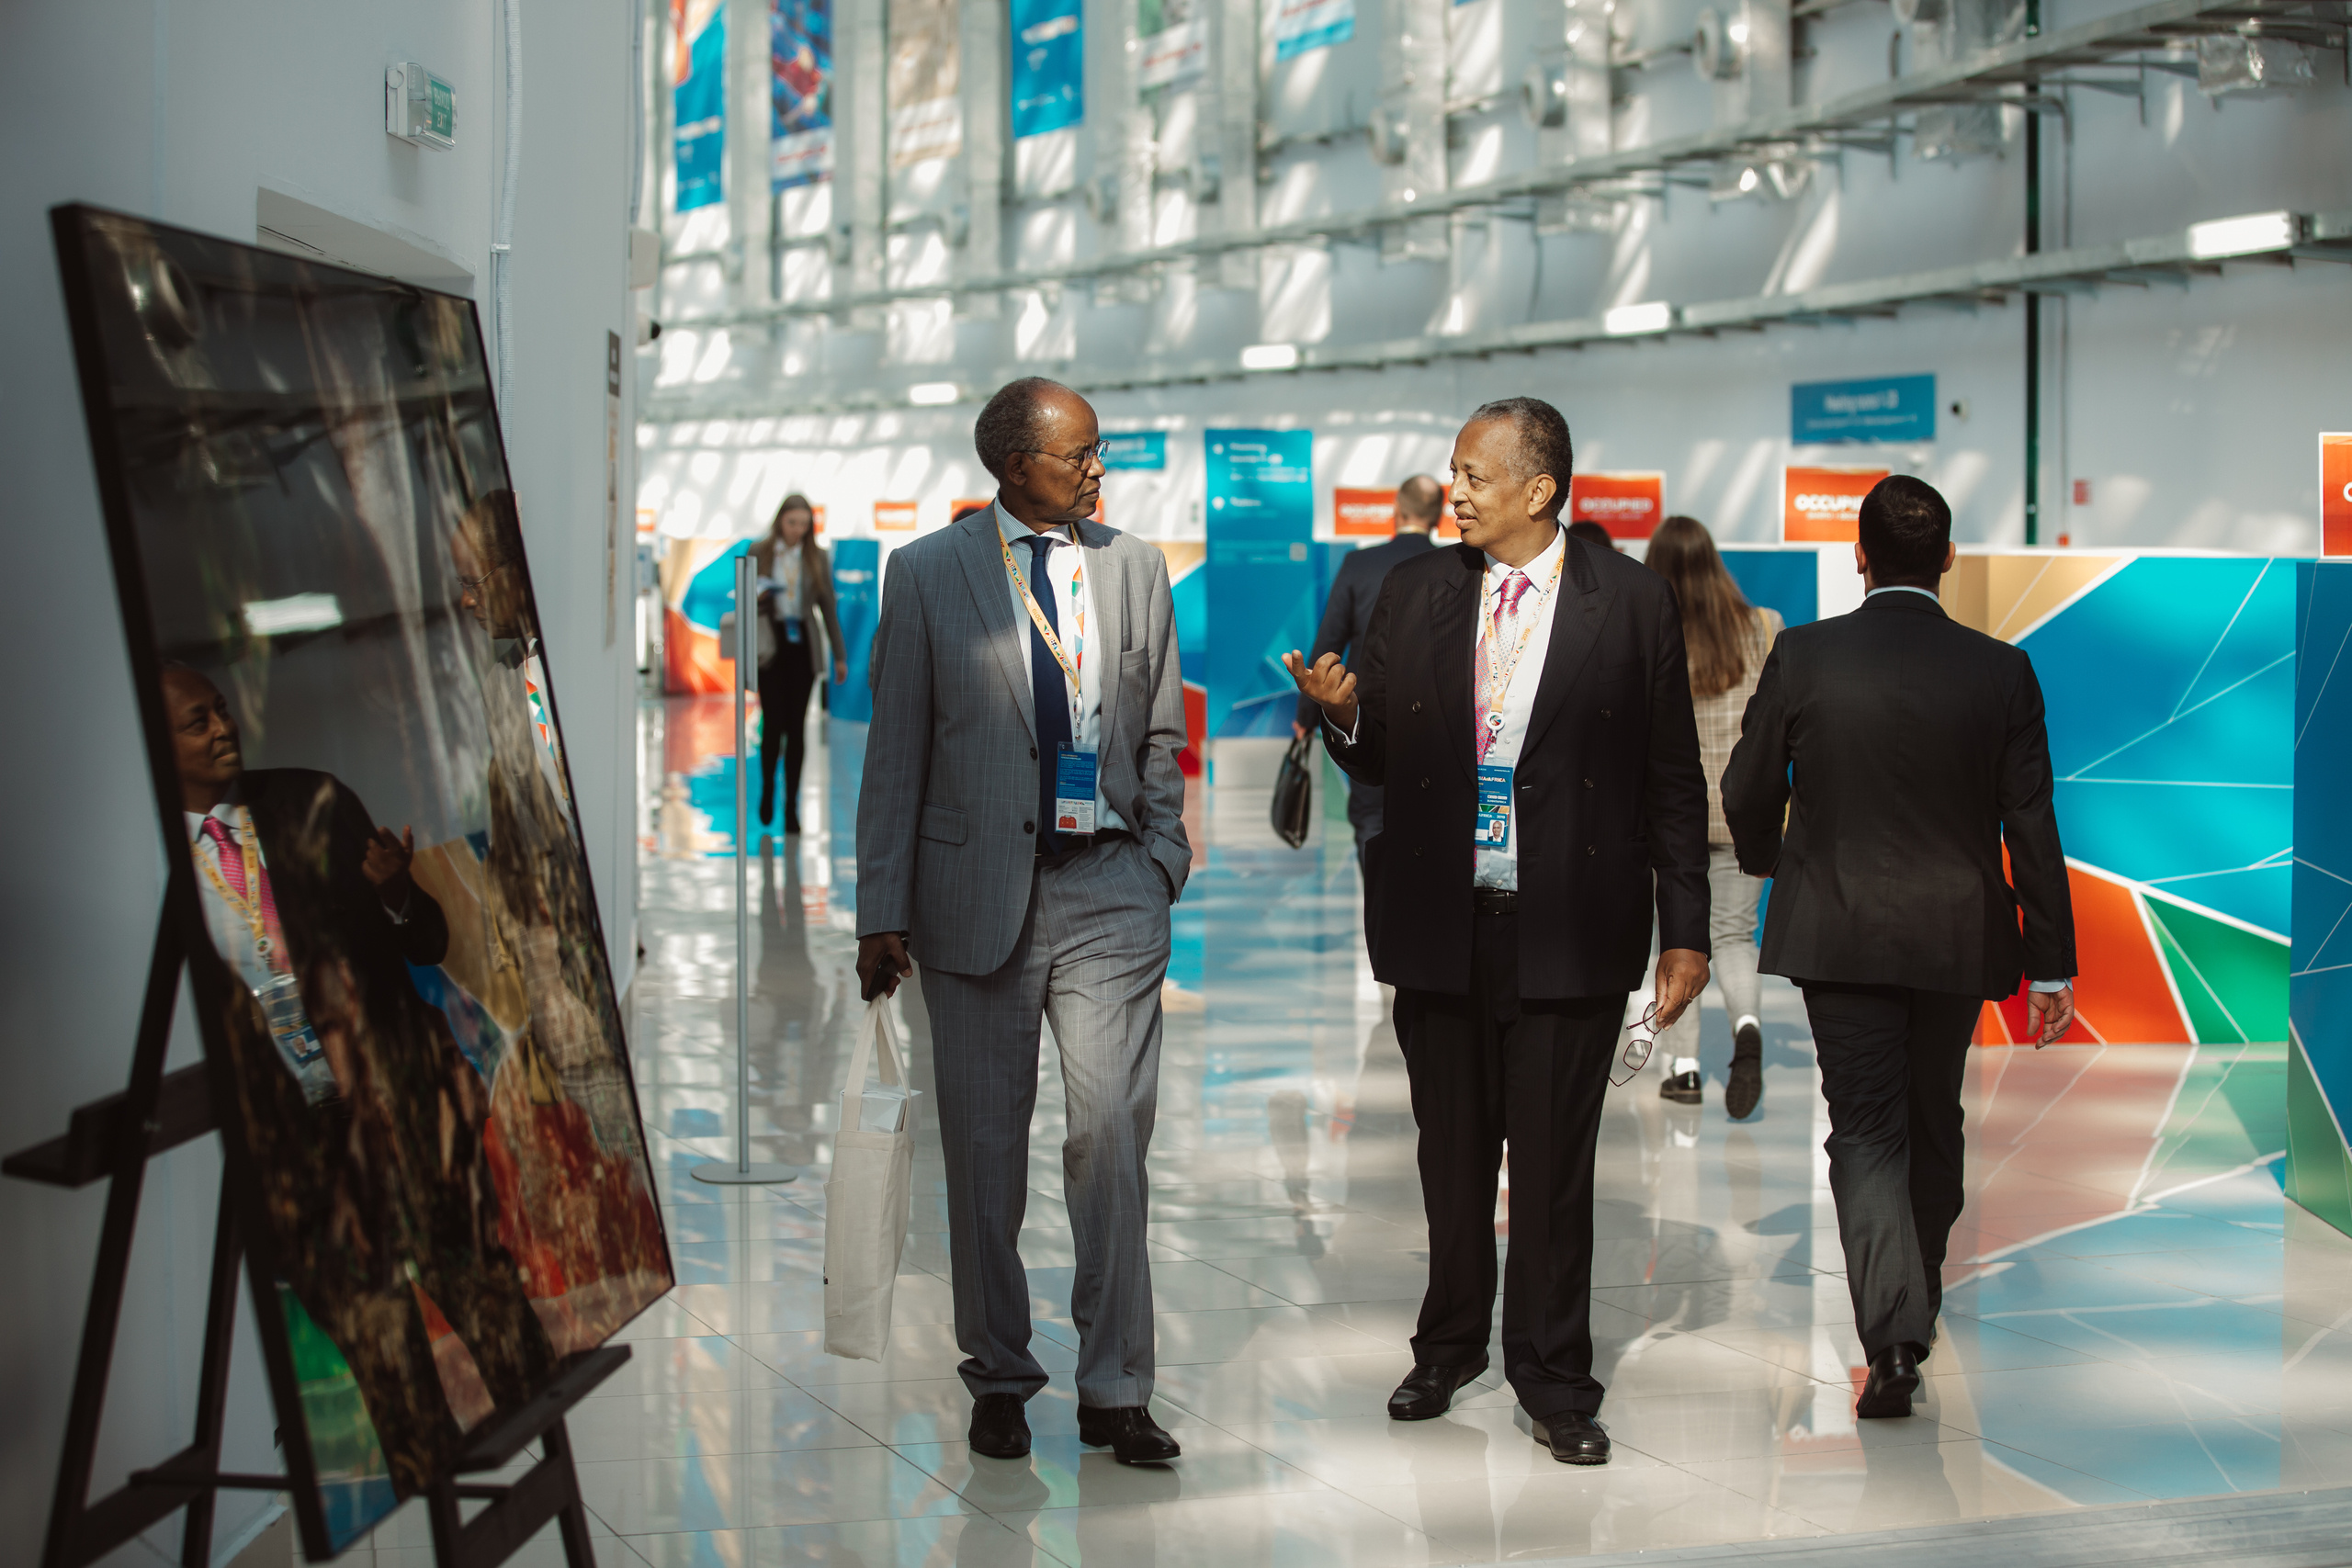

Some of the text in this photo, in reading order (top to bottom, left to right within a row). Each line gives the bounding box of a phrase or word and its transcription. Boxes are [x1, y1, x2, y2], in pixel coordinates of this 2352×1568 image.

[434, 86, 450, 112] ВЫХОД
[436, 111, 447, 130] EXIT
[1032, 608, 1043, 623] 2019
[1521, 627, 1531, 641] 2019
